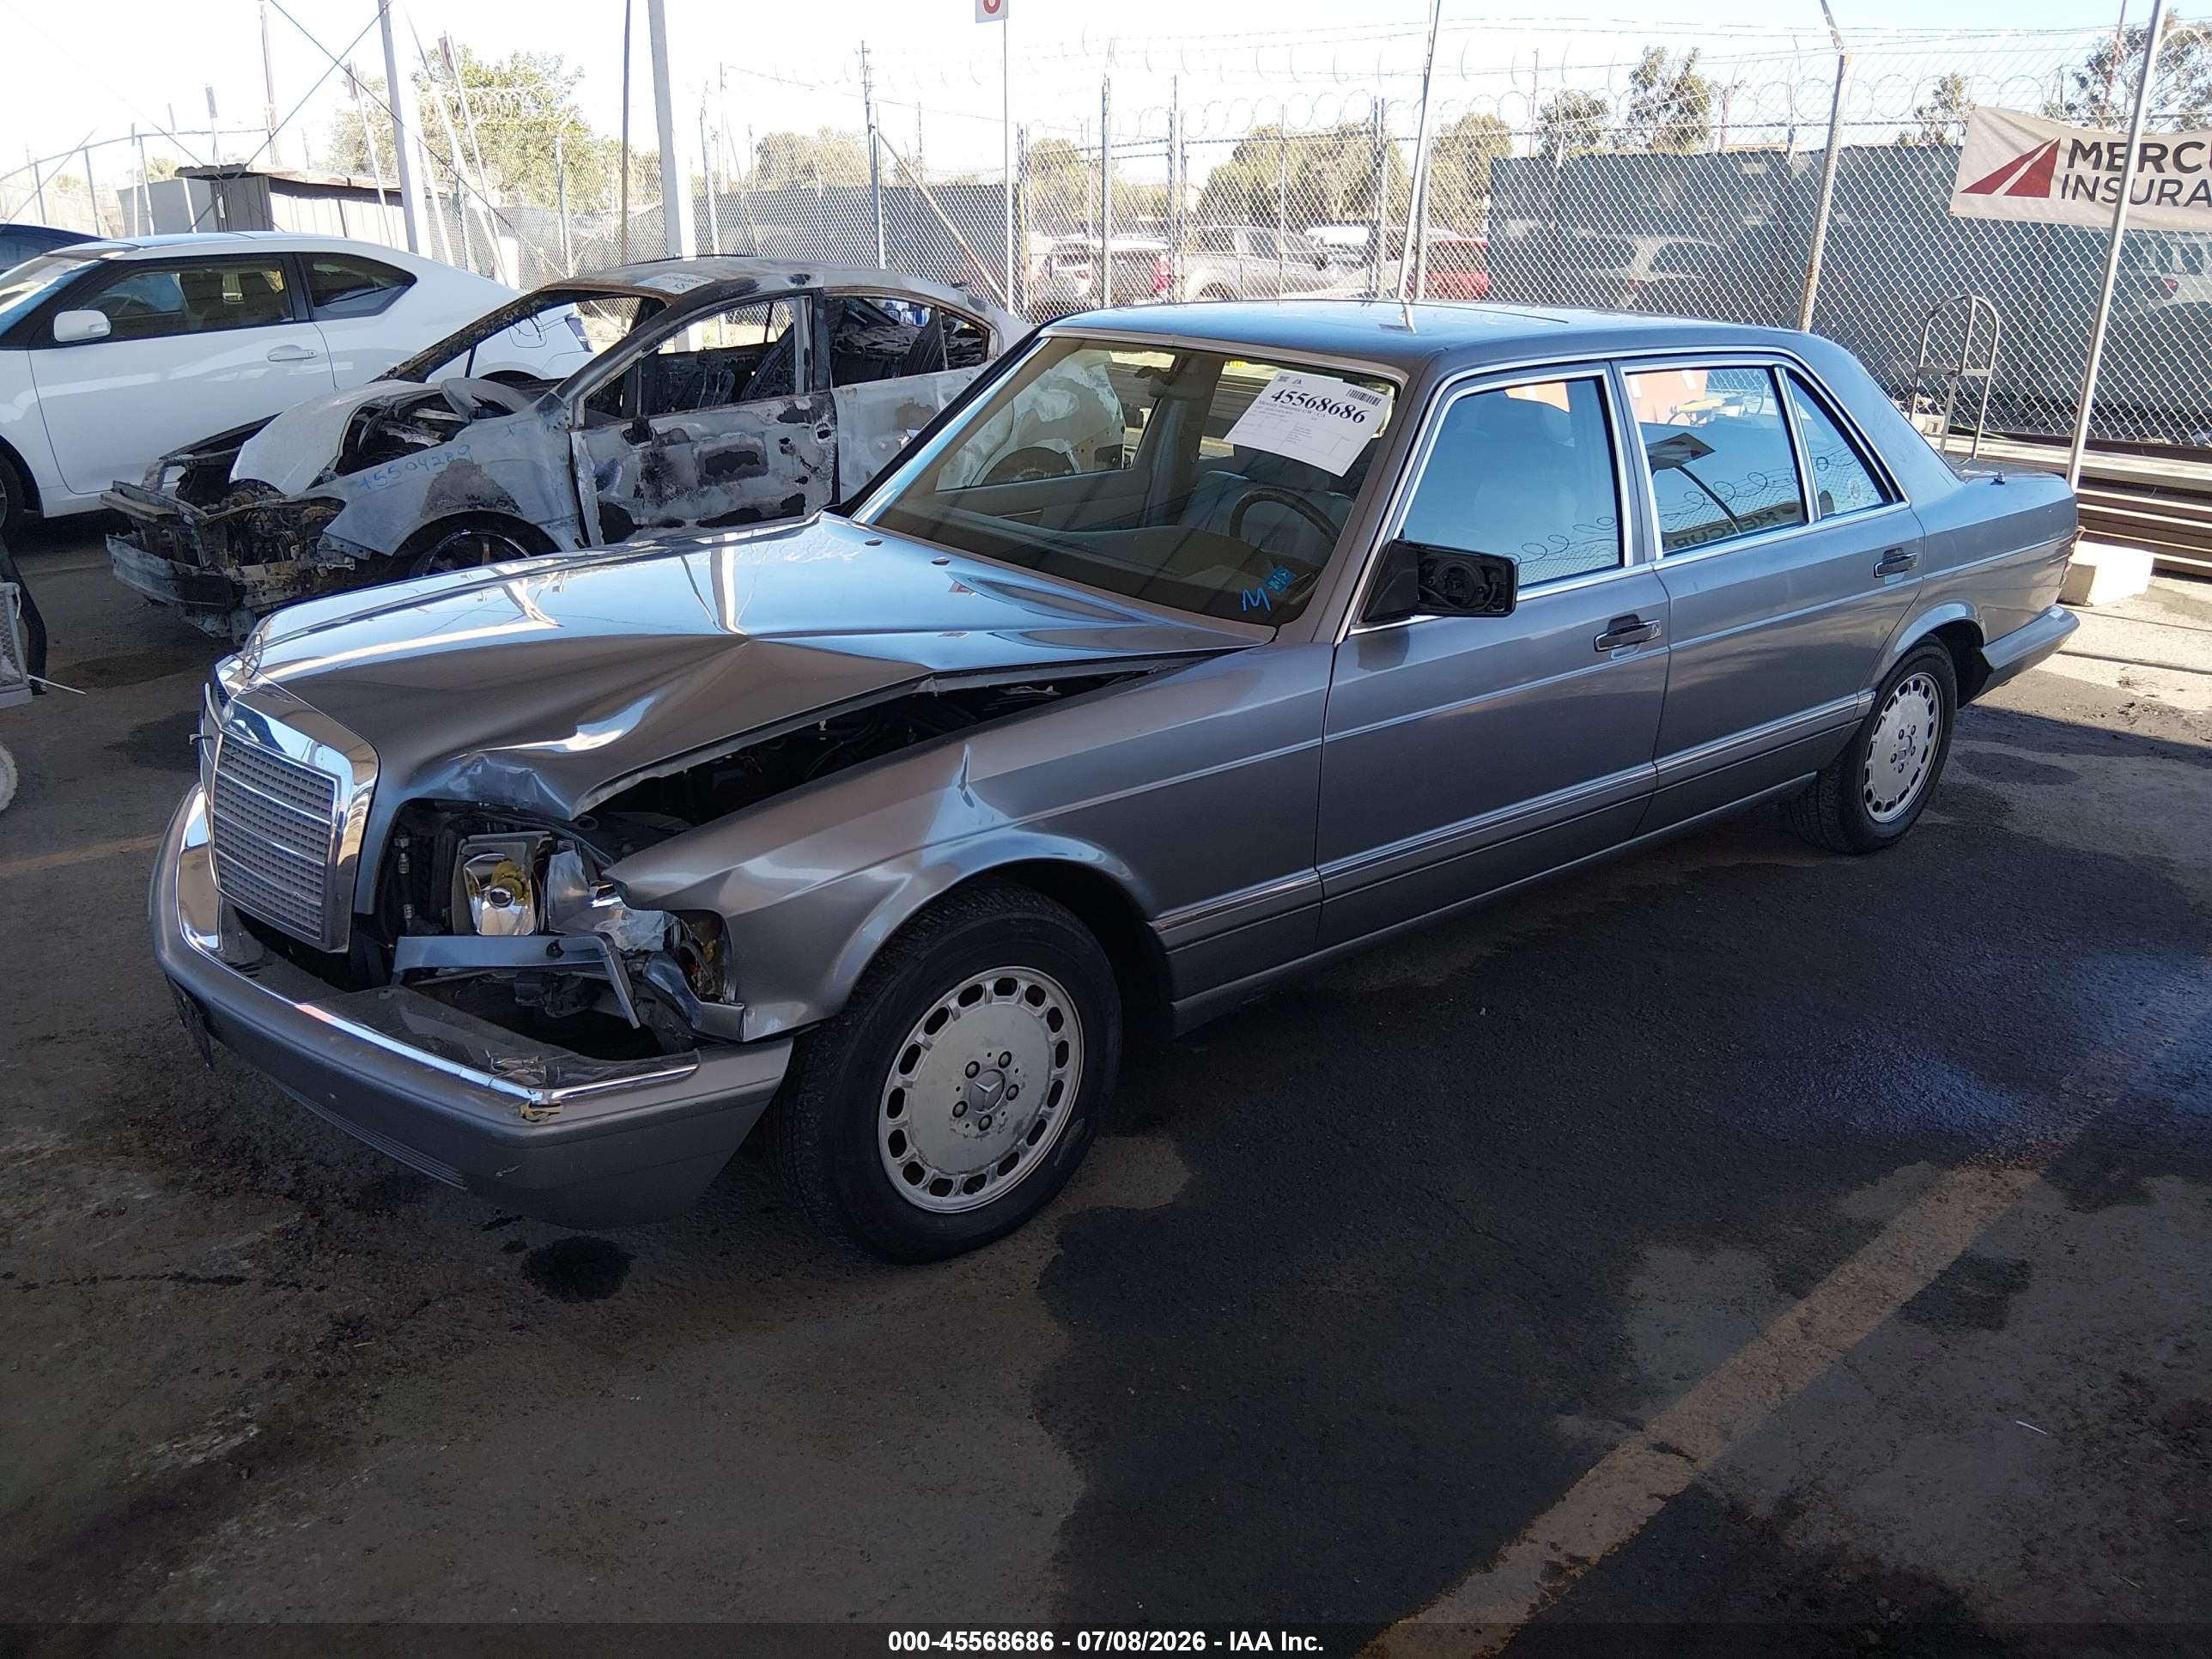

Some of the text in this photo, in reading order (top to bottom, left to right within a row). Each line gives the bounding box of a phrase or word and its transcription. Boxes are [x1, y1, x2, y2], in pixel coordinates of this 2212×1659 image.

[2068, 138, 2212, 173] MERC
[2061, 174, 2212, 207] INSURA
[1271, 388, 1370, 424] 45568686
[1243, 587, 1271, 611] M
